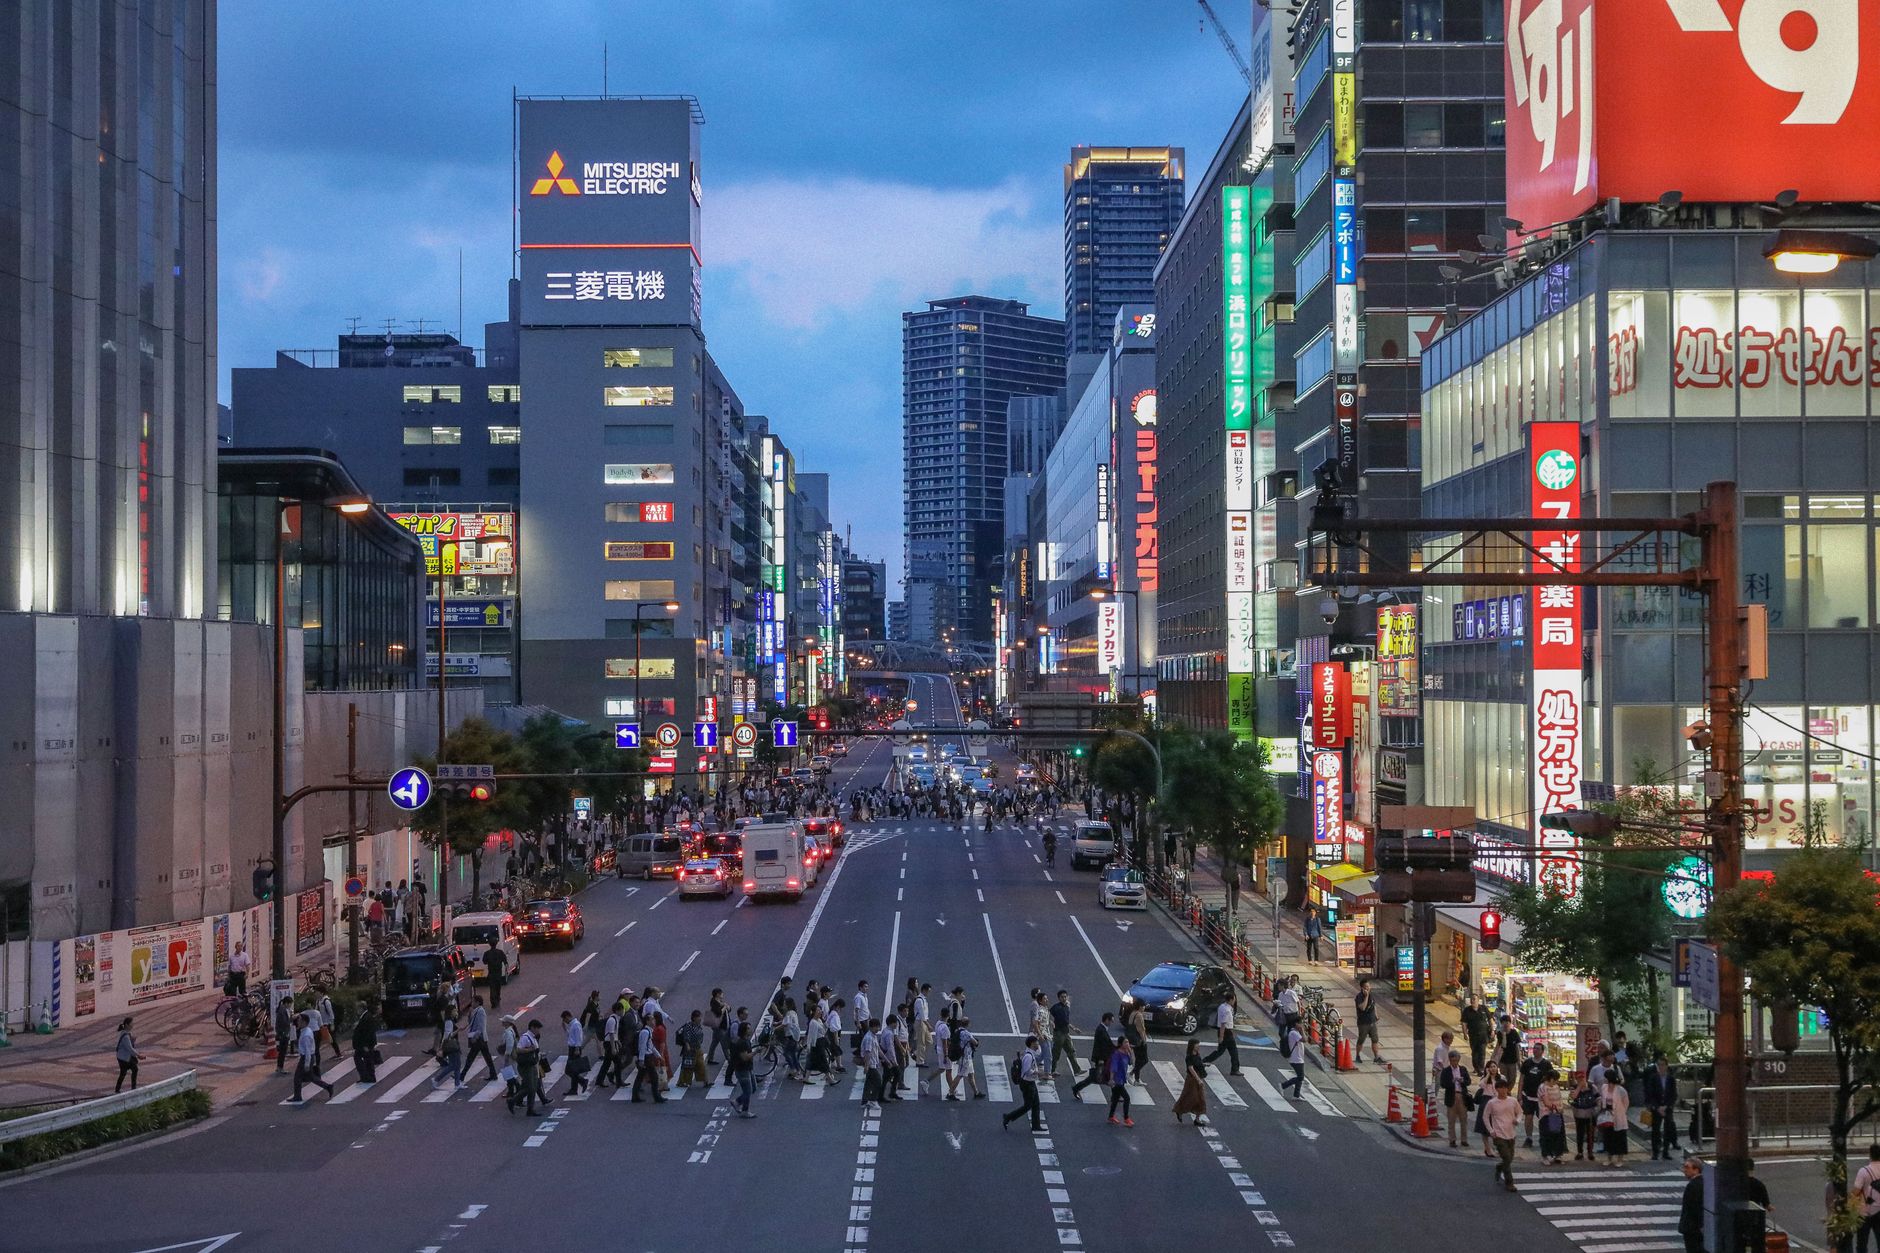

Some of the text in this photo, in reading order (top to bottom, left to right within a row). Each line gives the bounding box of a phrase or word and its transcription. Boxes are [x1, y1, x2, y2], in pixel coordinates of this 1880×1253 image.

[1336, 57, 1352, 67] 9F
[1339, 77, 1350, 115] ひまわり
[584, 162, 680, 178] MITSUBISHI
[1340, 167, 1351, 176] 8F
[584, 179, 667, 194] ELECTRIC
[1338, 212, 1353, 279] ラポート
[545, 270, 666, 301] 三菱電機
[1674, 325, 1880, 389] 処方せん
[1234, 536, 1246, 586] 証明写真
[1241, 676, 1250, 719] ストレッチ
[1322, 665, 1337, 744] カメラのナニワ
[1232, 699, 1241, 726] 専門店
[438, 767, 492, 777] 時差信号
[1764, 1061, 1786, 1073] 310
